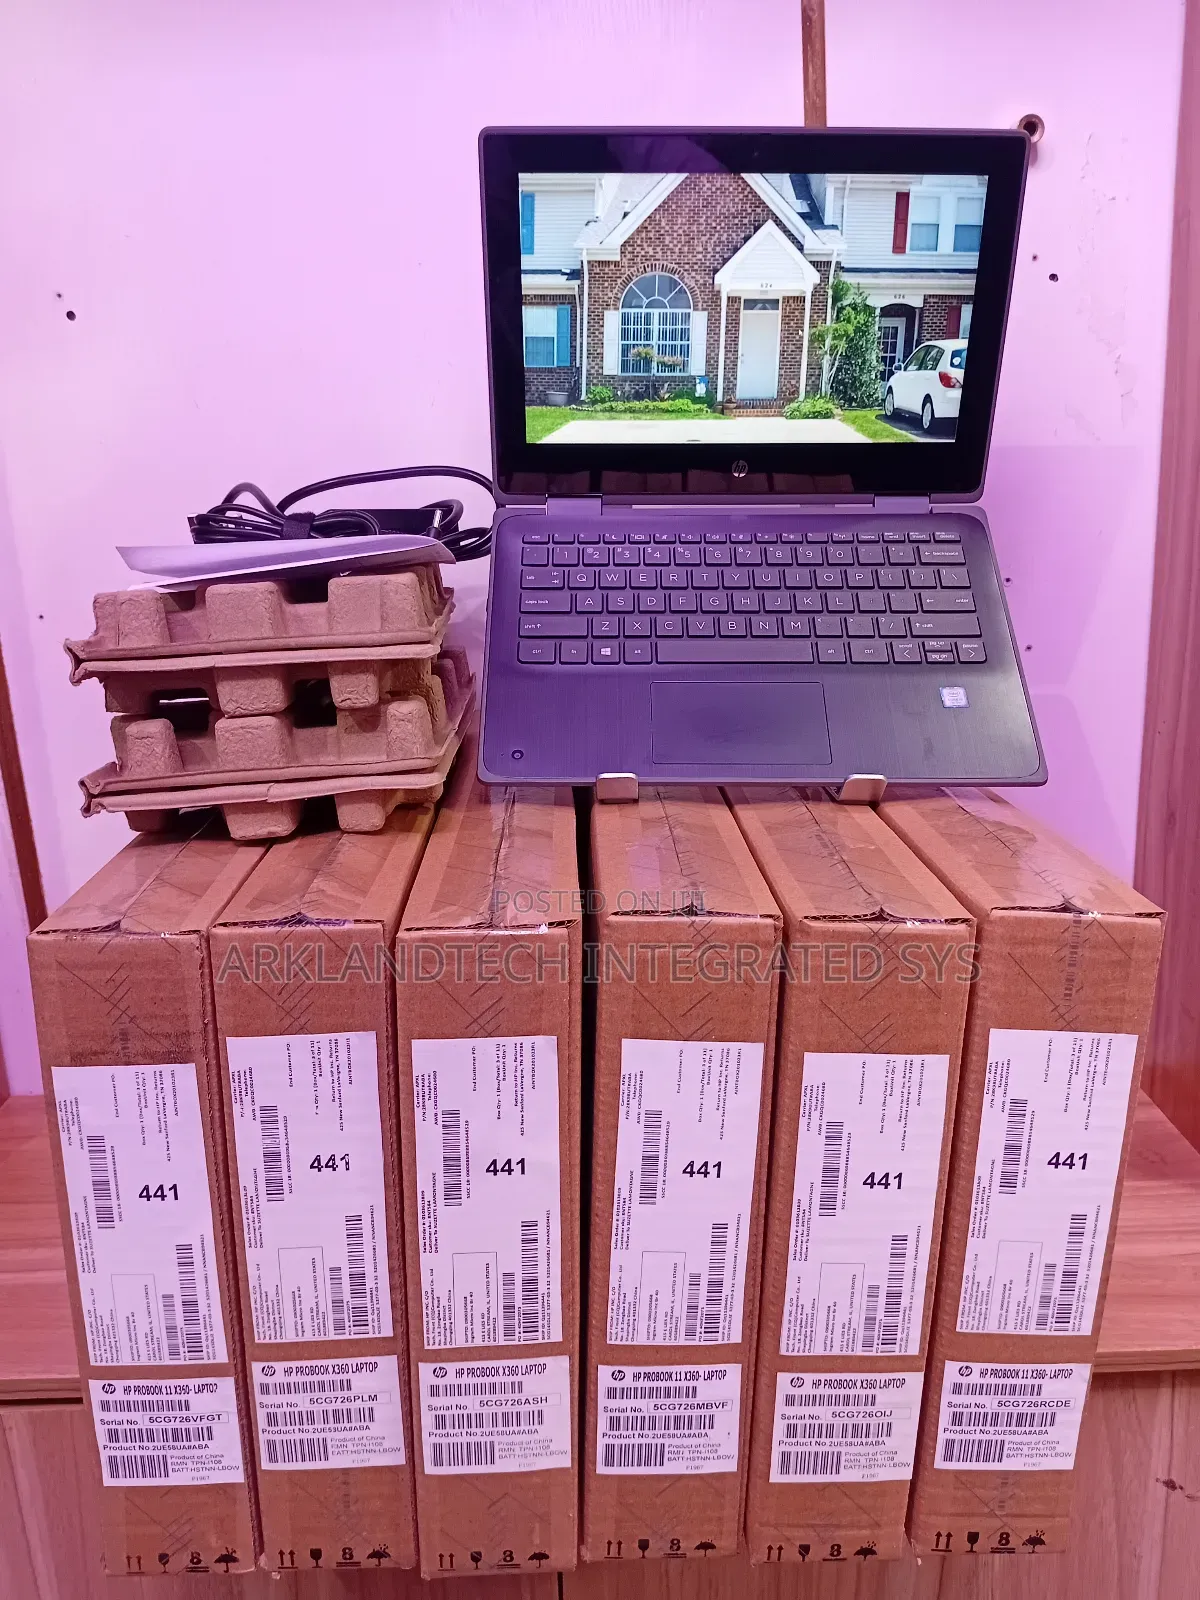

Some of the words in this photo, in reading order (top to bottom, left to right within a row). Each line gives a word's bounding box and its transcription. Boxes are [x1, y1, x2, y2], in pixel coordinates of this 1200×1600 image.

[577, 574, 587, 582] Q
[309, 1153, 350, 1173] 441
[1047, 1151, 1088, 1171] 441
[485, 1157, 526, 1177] 441
[682, 1160, 722, 1179] 441
[862, 1171, 903, 1190] 441
[138, 1183, 179, 1202] 441
[261, 1365, 276, 1376] hp
[284, 1368, 293, 1377] HP
[295, 1364, 329, 1377] PROBOOK
[332, 1364, 349, 1375] X360
[352, 1362, 378, 1374] LAPTOP
[433, 1366, 447, 1378] hp
[455, 1368, 465, 1379] HP
[467, 1367, 500, 1378] PROBOOK
[502, 1365, 519, 1376] X360
[521, 1363, 547, 1375] LAPTOP
[958, 1366, 973, 1377] hp
[980, 1368, 988, 1378] HP
[990, 1369, 1020, 1379] PROBOOK
[1021, 1369, 1028, 1379] 11
[1050, 1369, 1073, 1379] LAPTOP
[611, 1370, 625, 1381] hp
[633, 1372, 641, 1382] HP
[643, 1371, 673, 1382] PROBOOK
[675, 1371, 683, 1382] 11
[703, 1370, 727, 1381] LAPTOP
[790, 1377, 804, 1388] hp
[812, 1380, 822, 1389] HP
[823, 1379, 857, 1389] PROBOOK
[860, 1379, 877, 1389] X360
[879, 1378, 906, 1389] LAPTOP
[102, 1383, 116, 1394] hp
[123, 1385, 131, 1396] HP
[134, 1385, 163, 1396] PROBOOK
[165, 1385, 172, 1395] 11
[309, 1394, 378, 1405] 5CG726PLM
[479, 1397, 548, 1407] 5CG726ASH
[947, 1401, 971, 1409] Serial
[997, 1400, 1071, 1408] 5CG726RCDE
[653, 1402, 728, 1411] 5CG726MBVF
[148, 1414, 222, 1423] 5CG726VFGT
